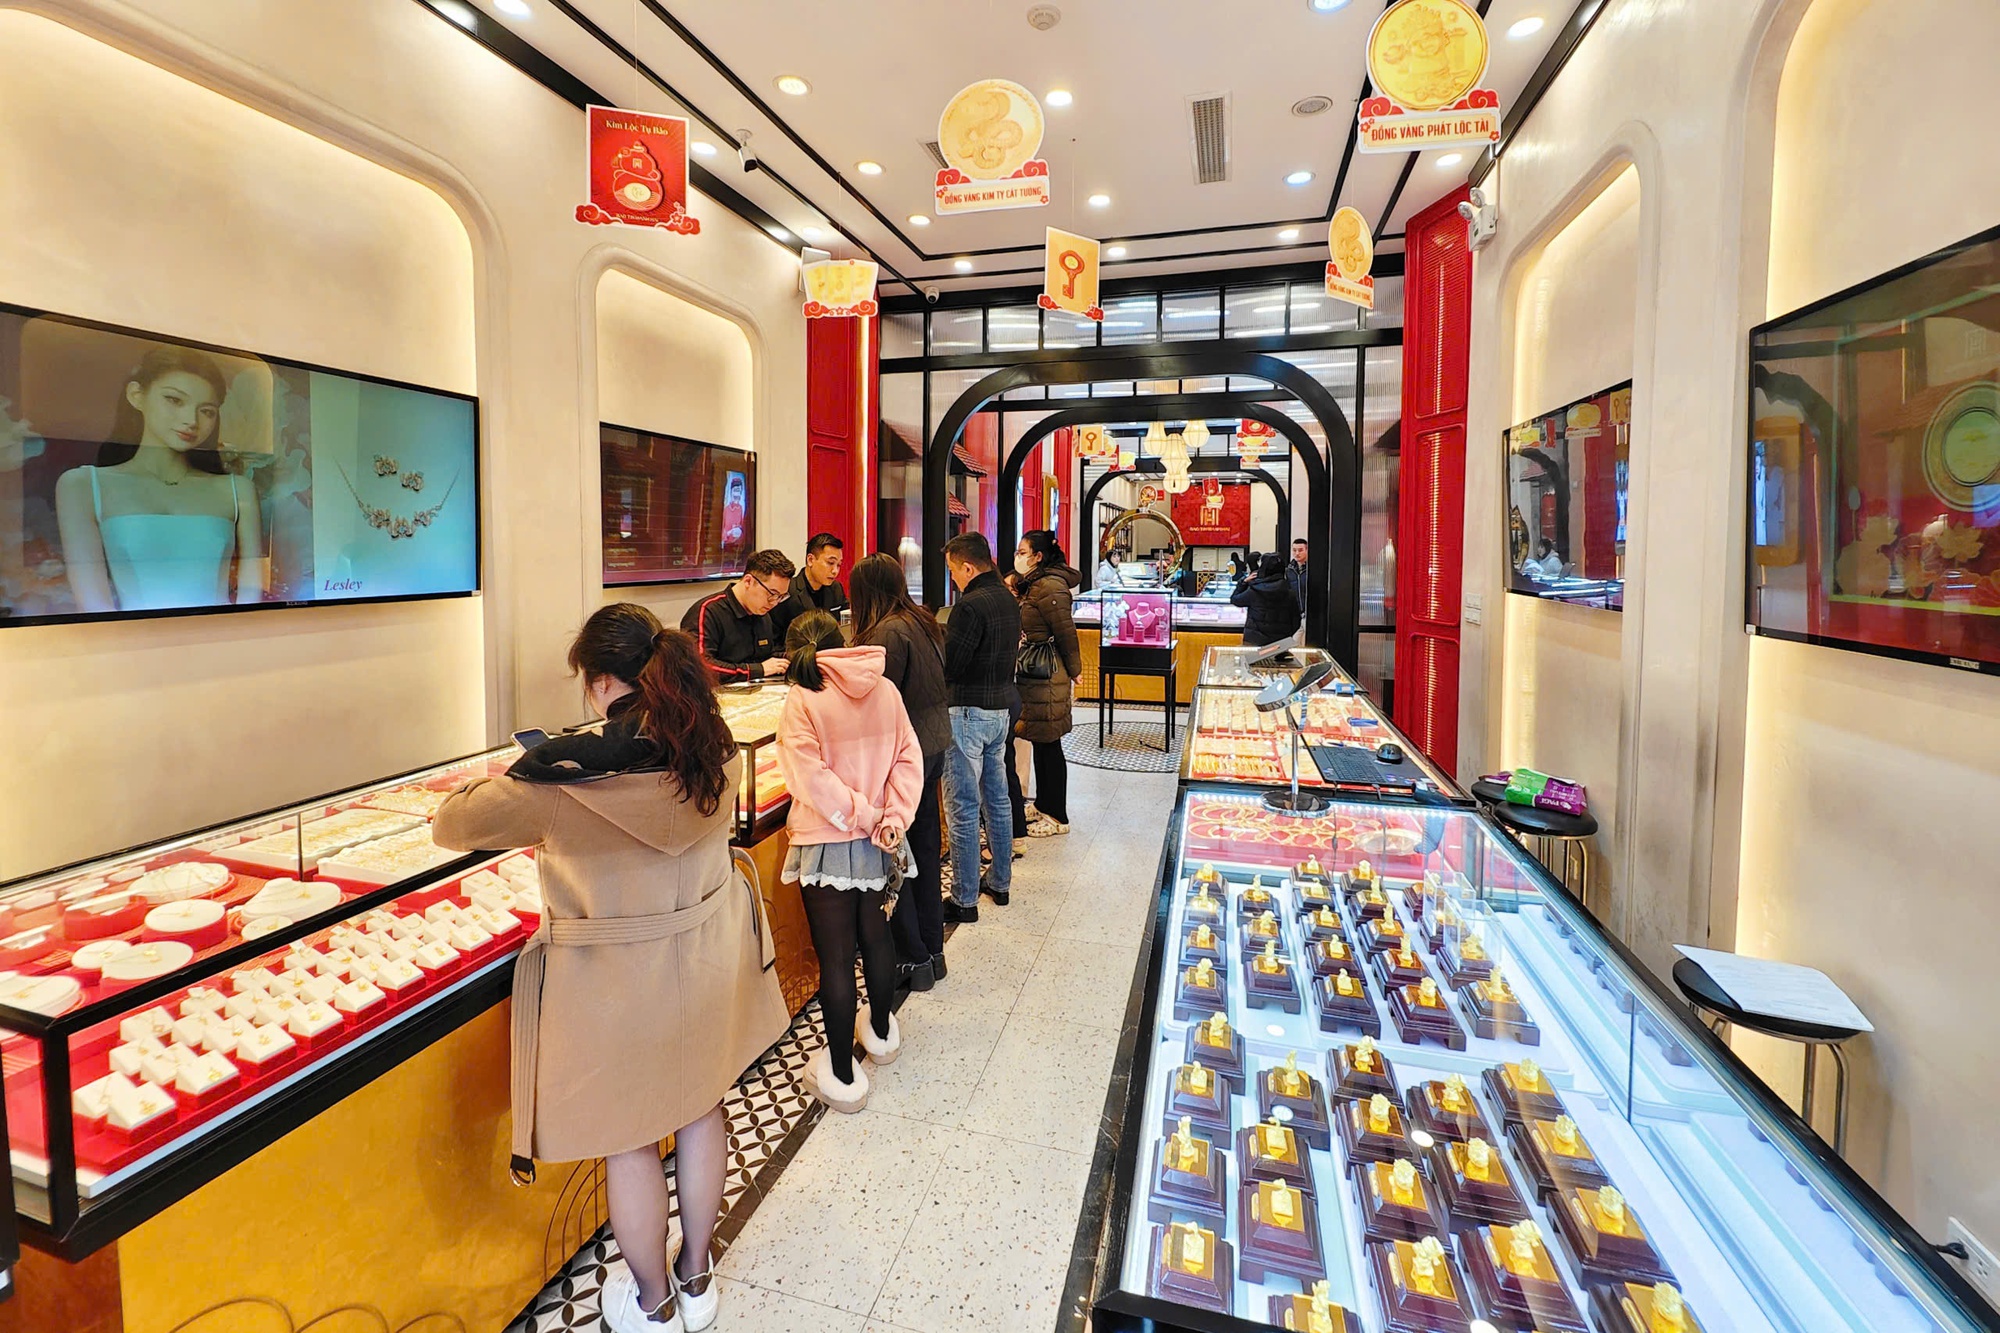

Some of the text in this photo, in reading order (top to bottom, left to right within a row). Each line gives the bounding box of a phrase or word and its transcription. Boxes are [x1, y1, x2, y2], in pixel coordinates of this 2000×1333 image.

[606, 119, 622, 129] Kim
[624, 122, 639, 132] Lộc
[1400, 123, 1424, 139] VÀNG
[1427, 121, 1451, 137] PHÁT
[1474, 118, 1489, 133] TÀI
[982, 191, 995, 201] KIM
[324, 578, 362, 592] Lesley
